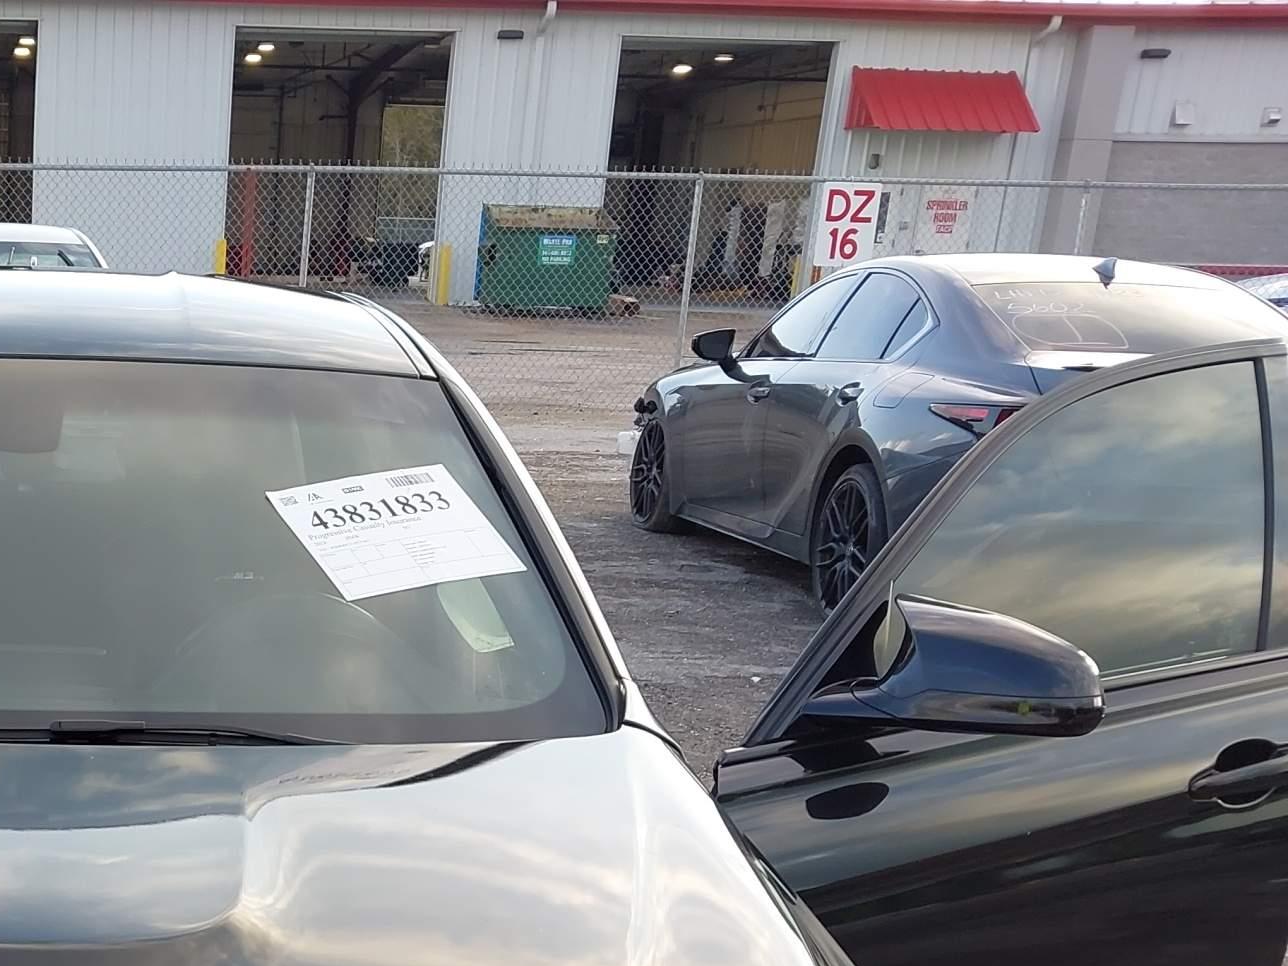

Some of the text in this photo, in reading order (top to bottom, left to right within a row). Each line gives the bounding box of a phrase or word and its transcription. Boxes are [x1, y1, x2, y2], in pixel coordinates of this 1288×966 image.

[825, 189, 875, 223] DZ
[933, 212, 957, 223] ROOM
[829, 228, 859, 260] 16
[311, 490, 451, 530] 43831833
